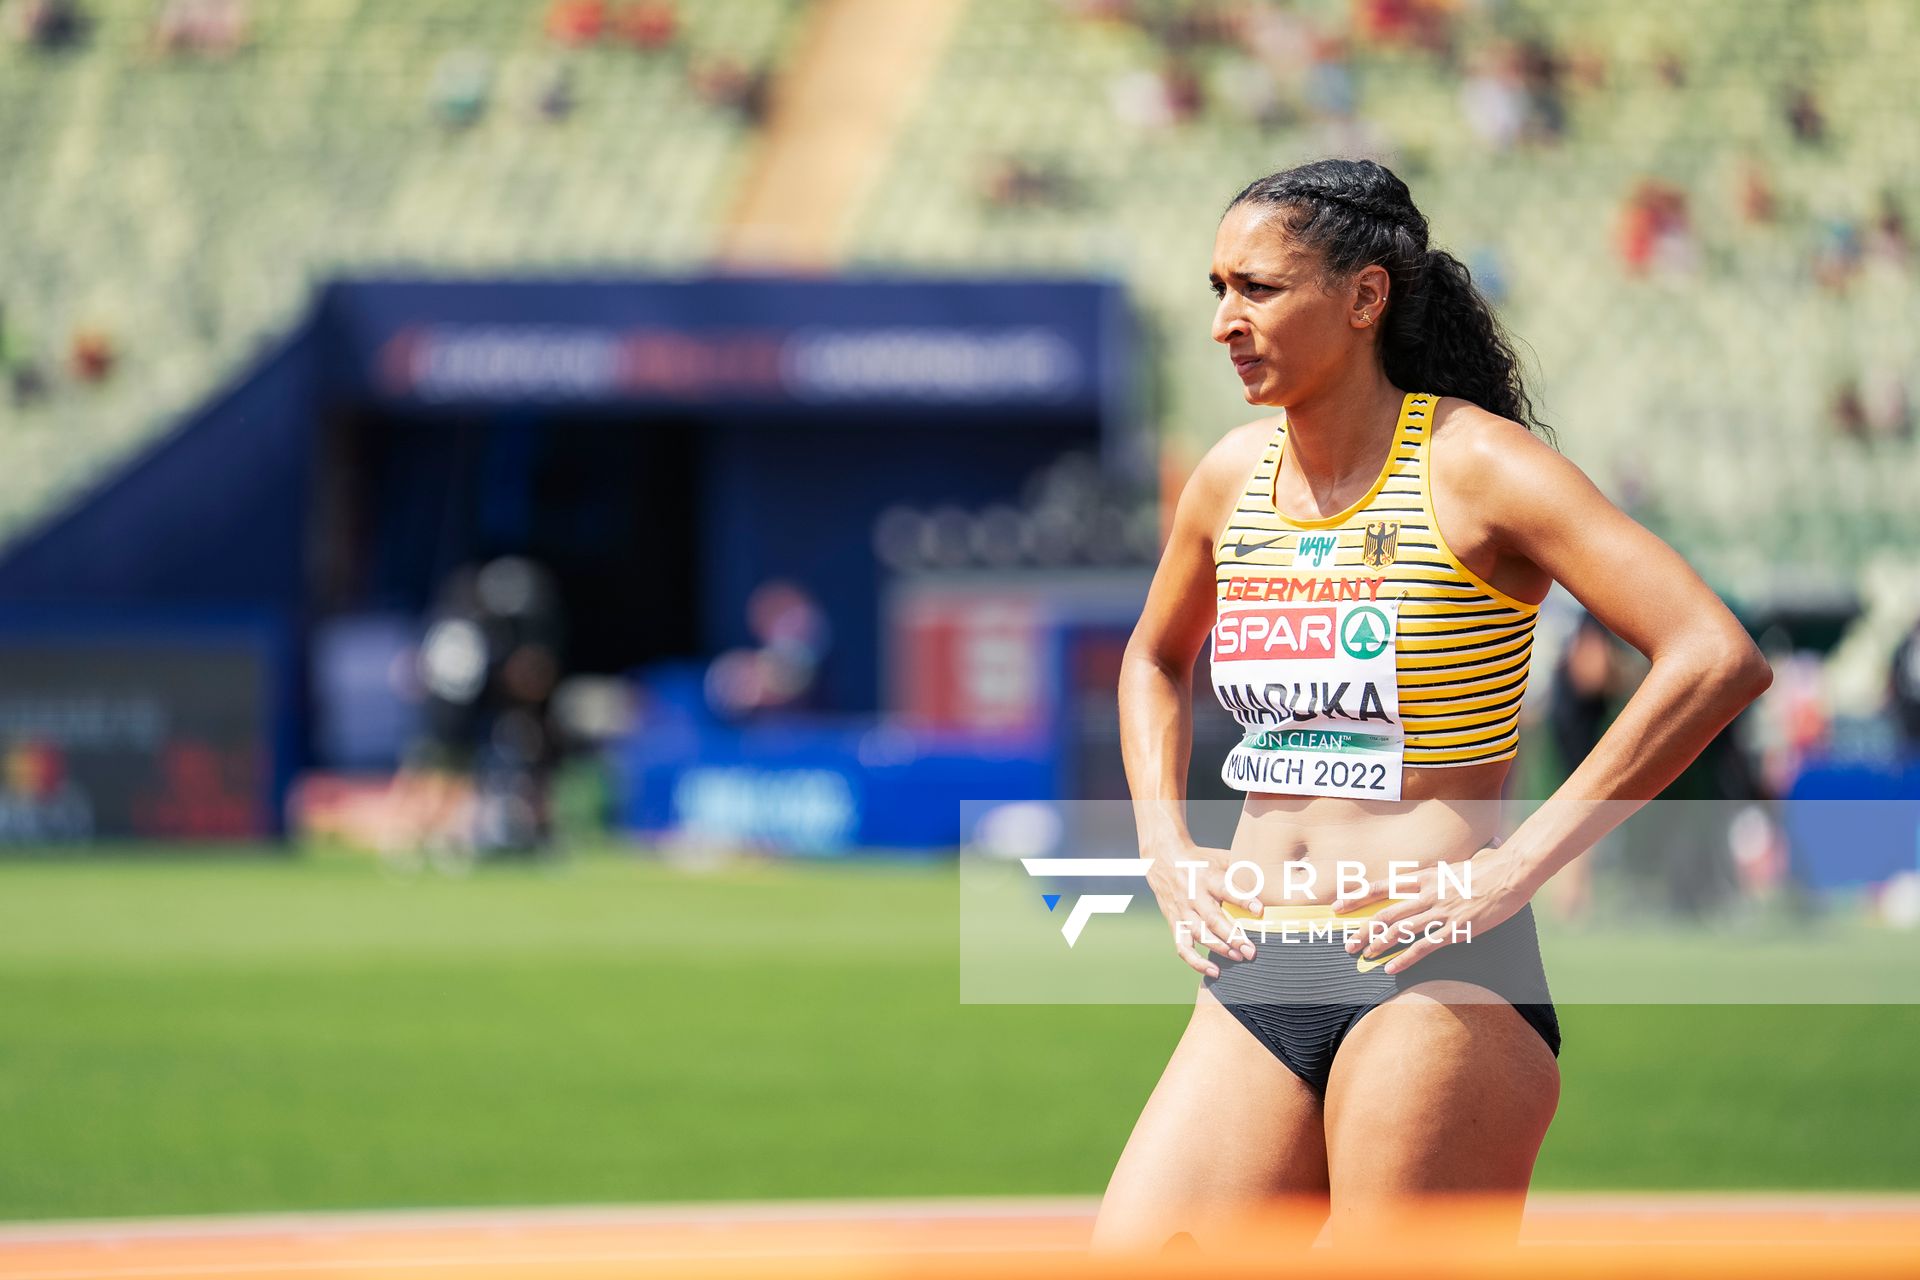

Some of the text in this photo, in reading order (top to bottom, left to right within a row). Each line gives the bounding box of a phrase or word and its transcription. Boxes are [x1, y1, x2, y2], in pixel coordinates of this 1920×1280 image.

[1226, 576, 1387, 602] GERMANY
[1217, 615, 1332, 655] SPAR
[1218, 682, 1395, 724] MADUKA
[1227, 754, 1387, 790] MUNICH 2022
